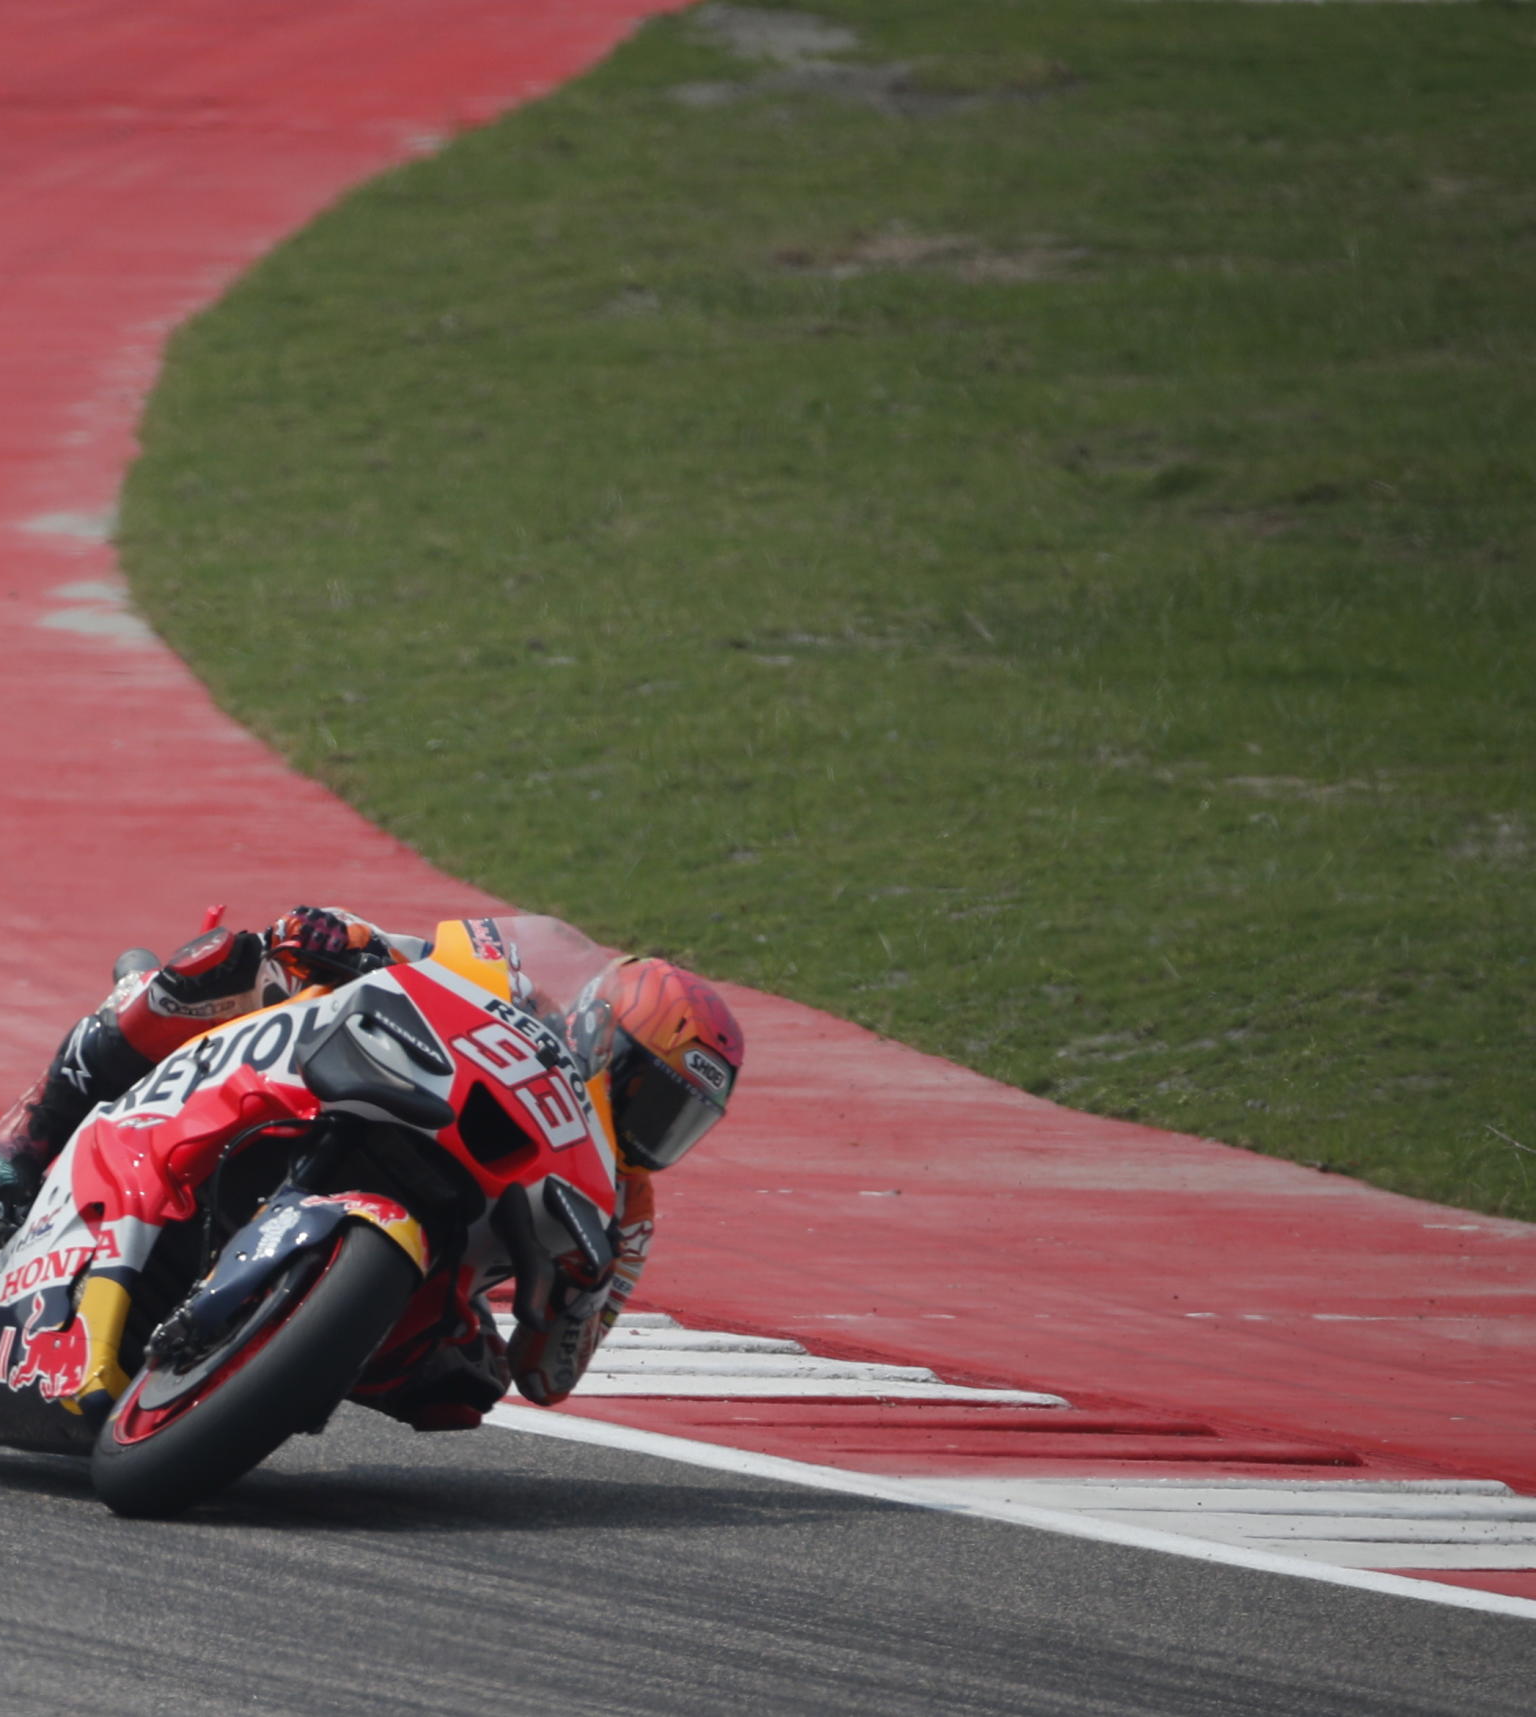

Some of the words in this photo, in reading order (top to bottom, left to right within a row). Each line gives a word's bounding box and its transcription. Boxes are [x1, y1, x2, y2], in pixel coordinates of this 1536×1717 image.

[374, 1010, 445, 1064] HONDA
[449, 1021, 589, 1152] 93
[0, 1229, 122, 1304] HONDA
